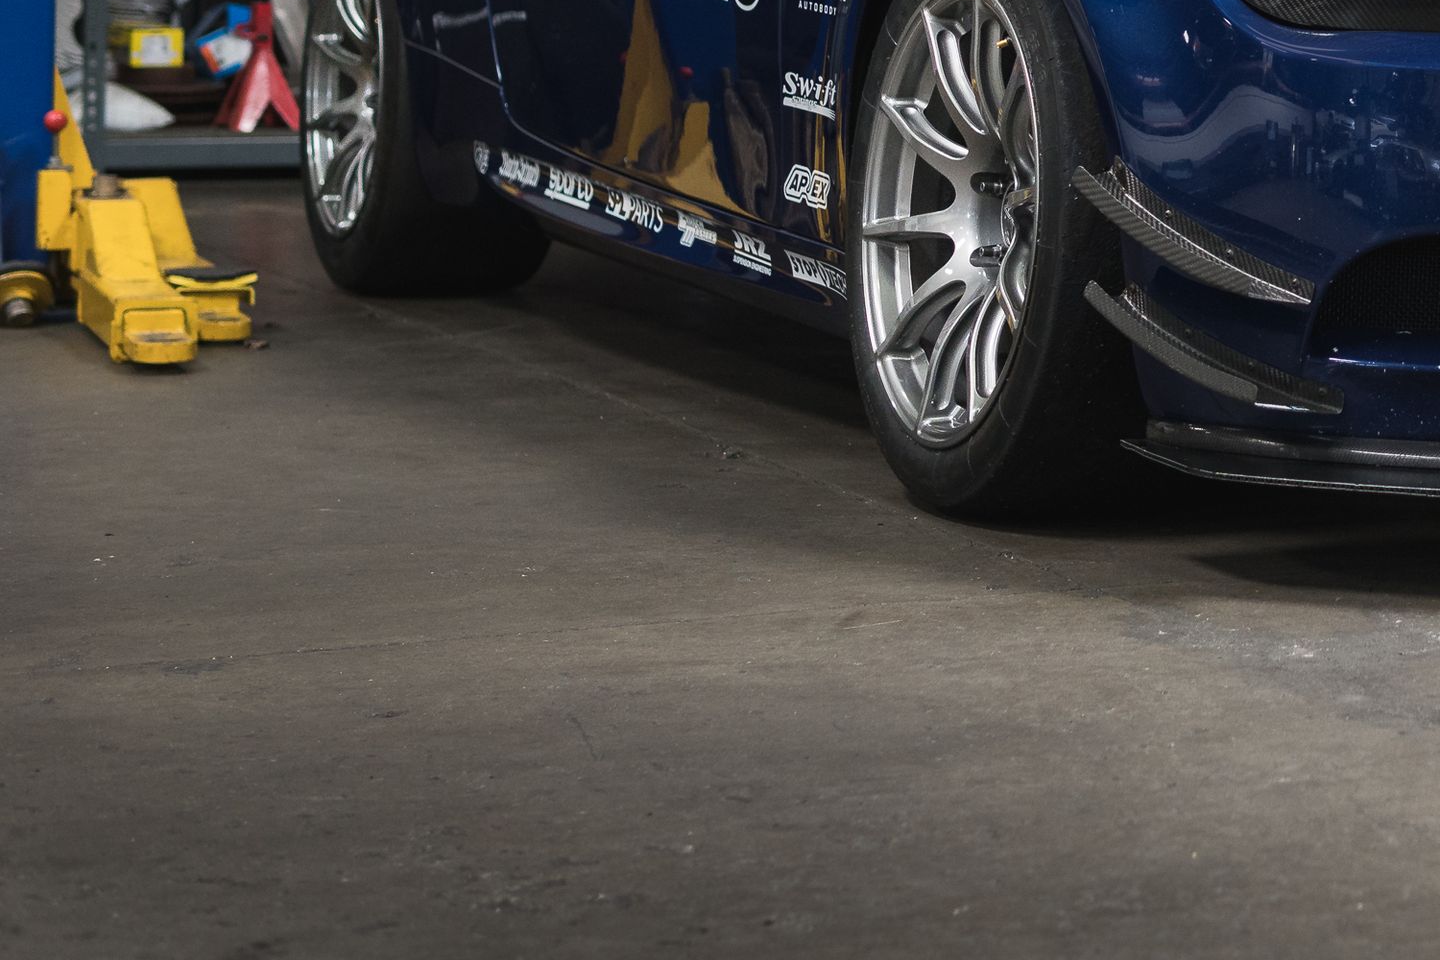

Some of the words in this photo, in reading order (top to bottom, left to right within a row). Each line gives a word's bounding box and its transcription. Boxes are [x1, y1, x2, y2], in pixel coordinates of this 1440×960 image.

[798, 0, 837, 16] AUTOBODY
[628, 194, 663, 233] PARTS
[732, 230, 771, 260] JRZ
